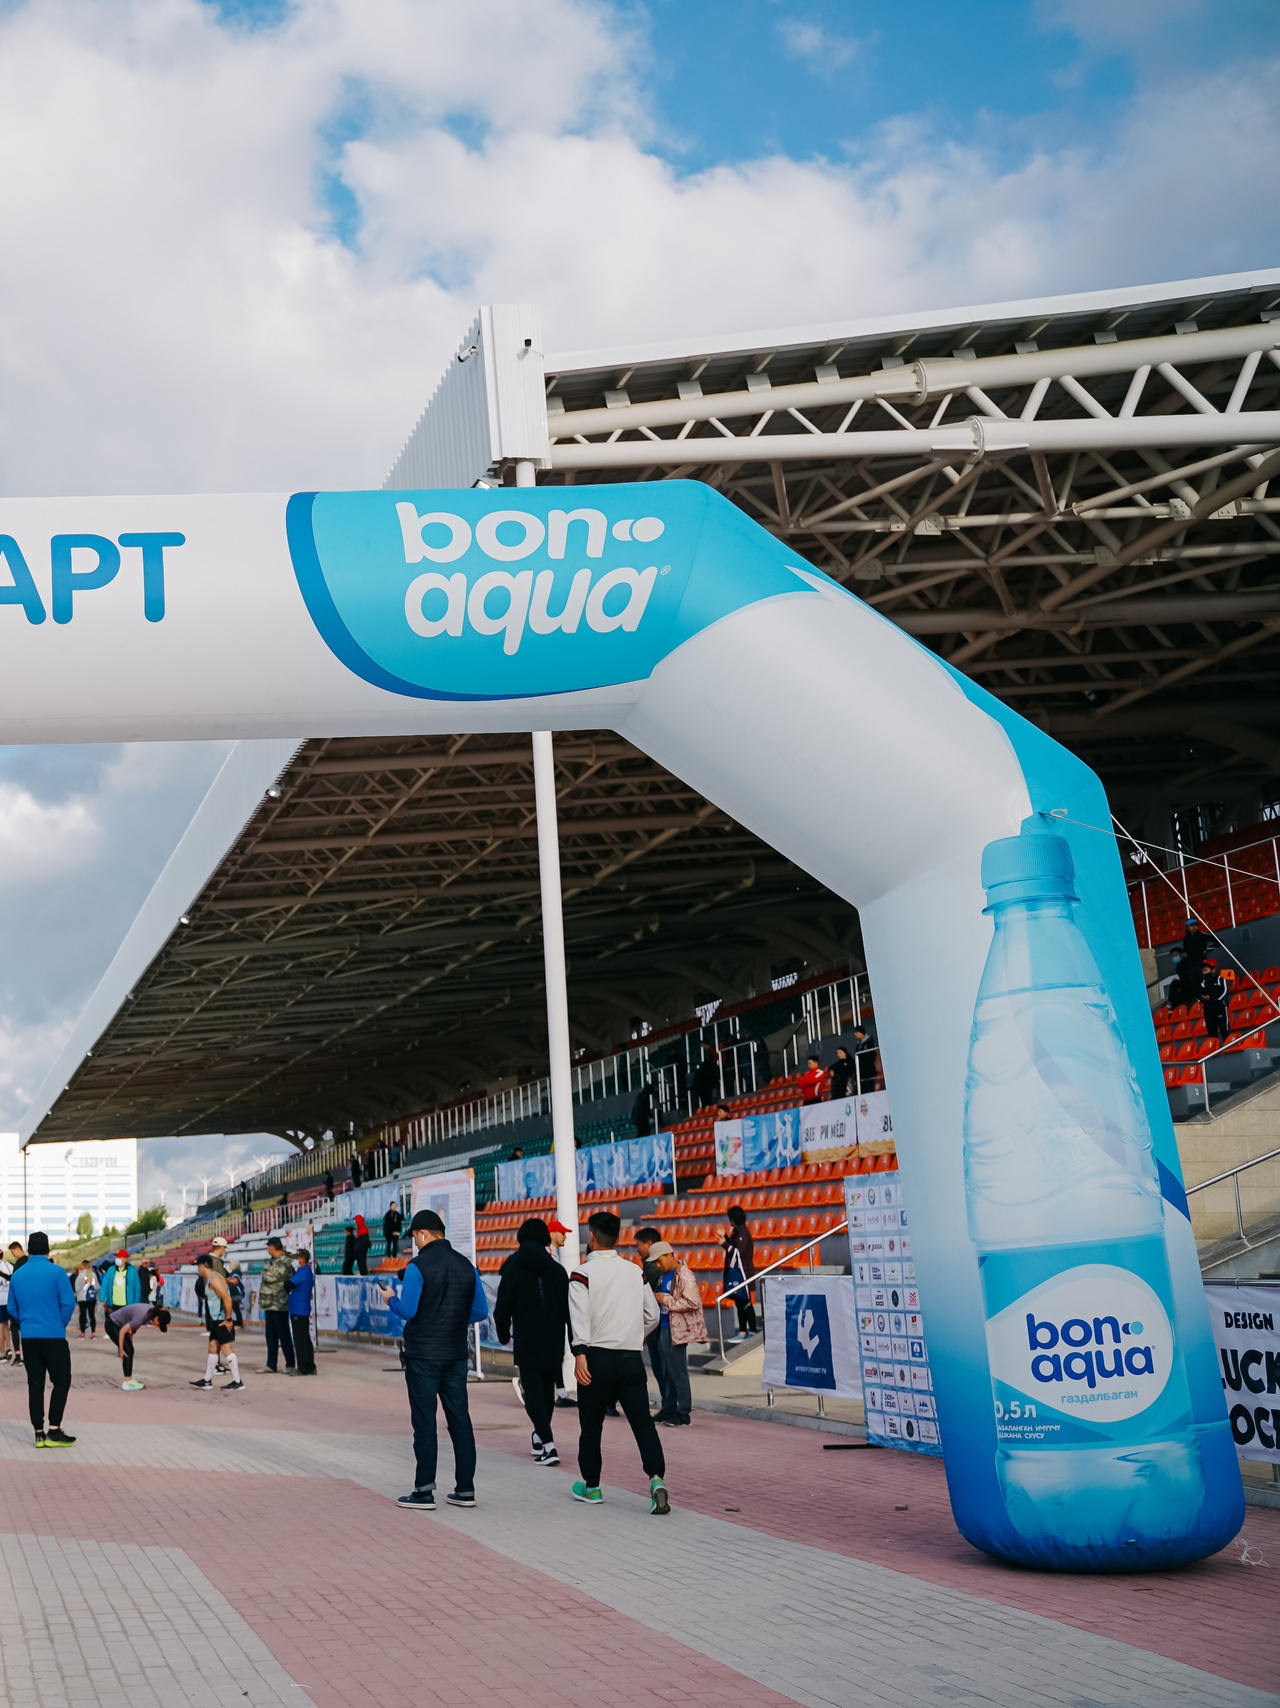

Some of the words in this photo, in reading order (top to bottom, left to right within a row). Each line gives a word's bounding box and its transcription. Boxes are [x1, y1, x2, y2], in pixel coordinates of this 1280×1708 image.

[394, 501, 608, 564] bon
[404, 566, 658, 656] aqua
[1025, 1312, 1122, 1351] bon
[1223, 1311, 1275, 1331] DESIGN
[1030, 1345, 1155, 1389] aqua
[1060, 1390, 1138, 1404] газдалбаган
